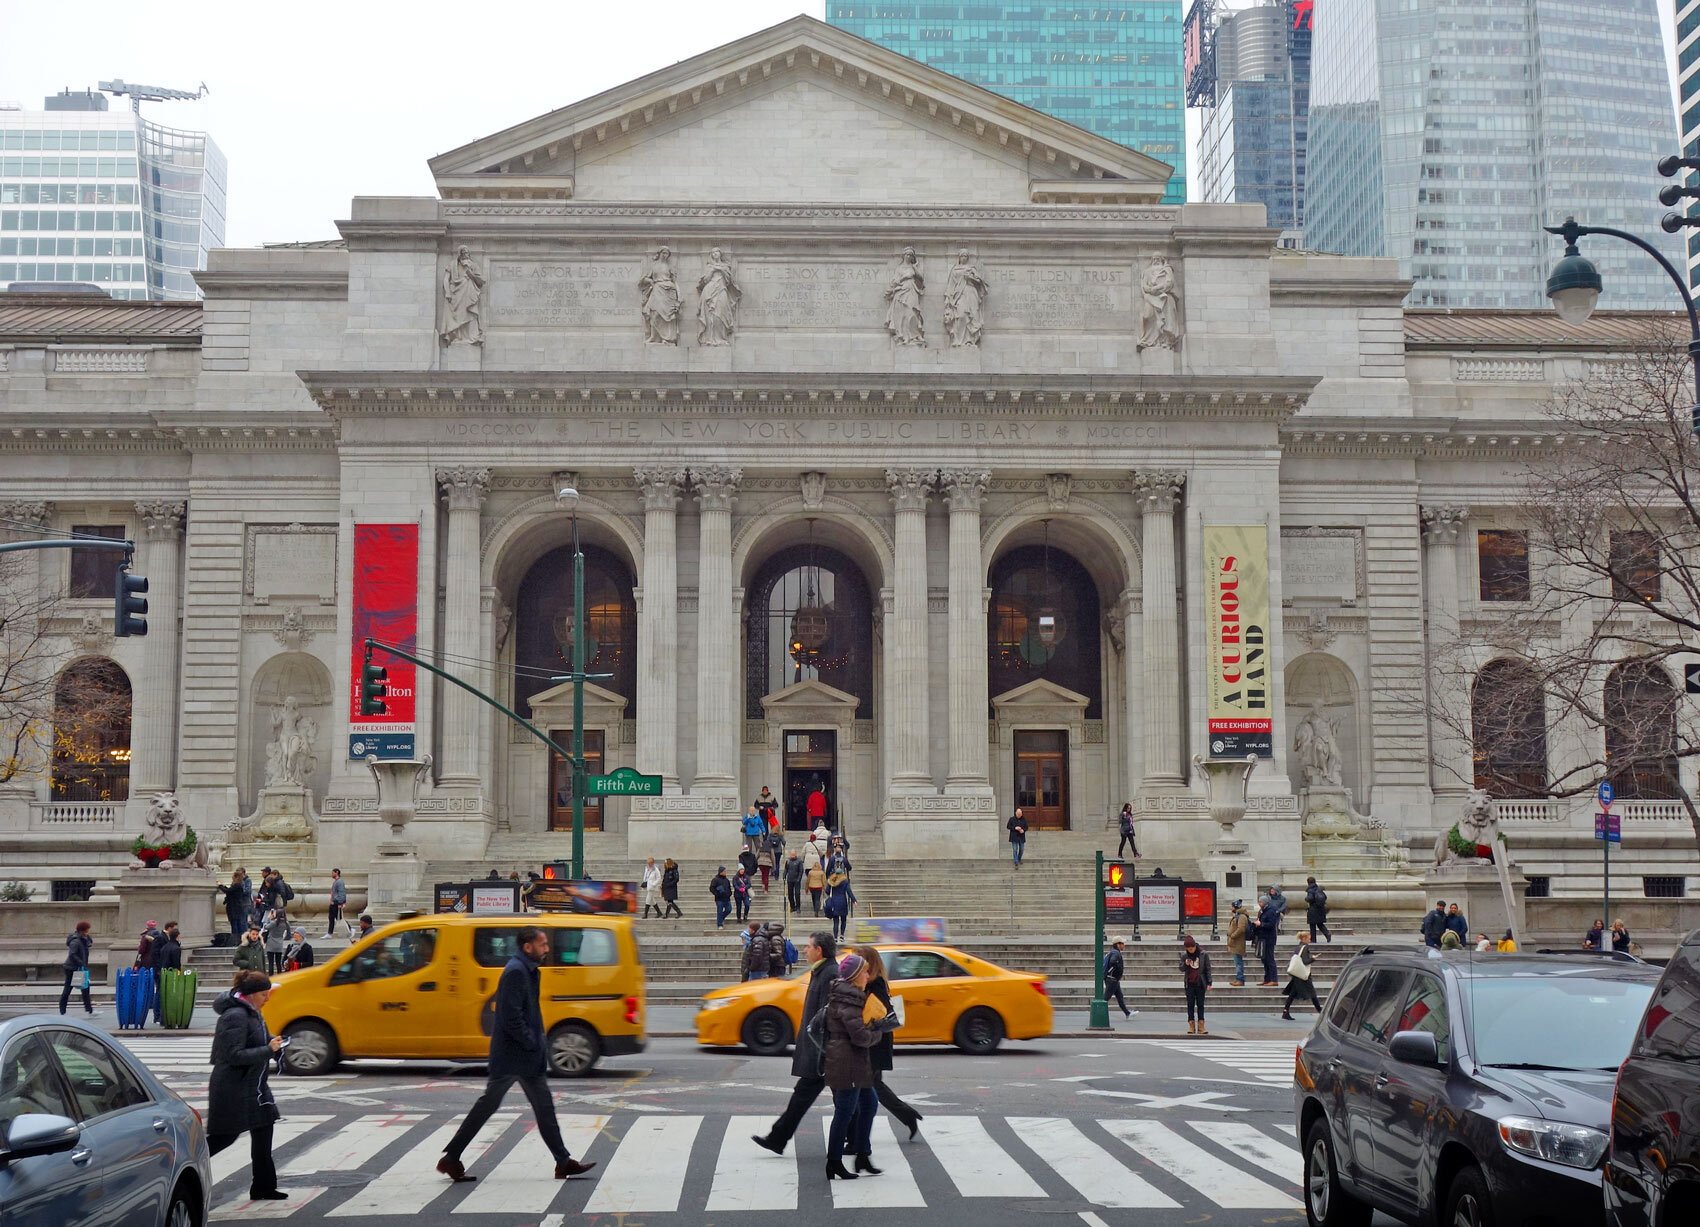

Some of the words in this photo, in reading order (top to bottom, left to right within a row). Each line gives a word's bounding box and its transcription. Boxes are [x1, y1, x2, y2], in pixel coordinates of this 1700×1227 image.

[496, 266, 522, 278] THE
[530, 266, 573, 278] ASTOR
[578, 266, 633, 278] LIBRARY
[746, 267, 771, 279] THE
[778, 267, 820, 279] LENOX
[826, 267, 881, 279] LIBRARY
[991, 270, 1016, 282] THE
[1027, 270, 1073, 282] TILDEN
[1083, 270, 1125, 282] TRUST
[514, 290, 542, 299] JOHN
[546, 290, 579, 299] JACOB
[584, 290, 616, 299] ASTOR
[775, 291, 809, 300] JAMES
[817, 291, 850, 300] LENOX
[1007, 293, 1042, 302] SAMUEL
[1046, 293, 1075, 302] JONES
[1080, 293, 1112, 302] TILDEN
[763, 301, 806, 309] DEDICATED
[1041, 303, 1057, 311] THE
[445, 423, 537, 436] MDCCCXCV
[588, 421, 641, 438] THE
[660, 421, 721, 438] NEW
[743, 421, 808, 439] YORK
[827, 421, 913, 439] PUBLIC
[935, 421, 1037, 439] LIBRARY
[1087, 426, 1168, 439] MDCCCCII
[1220, 556, 1241, 684] CURIOUS
[1245, 624, 1266, 709] HAND
[1222, 690, 1242, 710] A
[596, 780, 624, 791] Fifth
[628, 780, 651, 791] Ave
